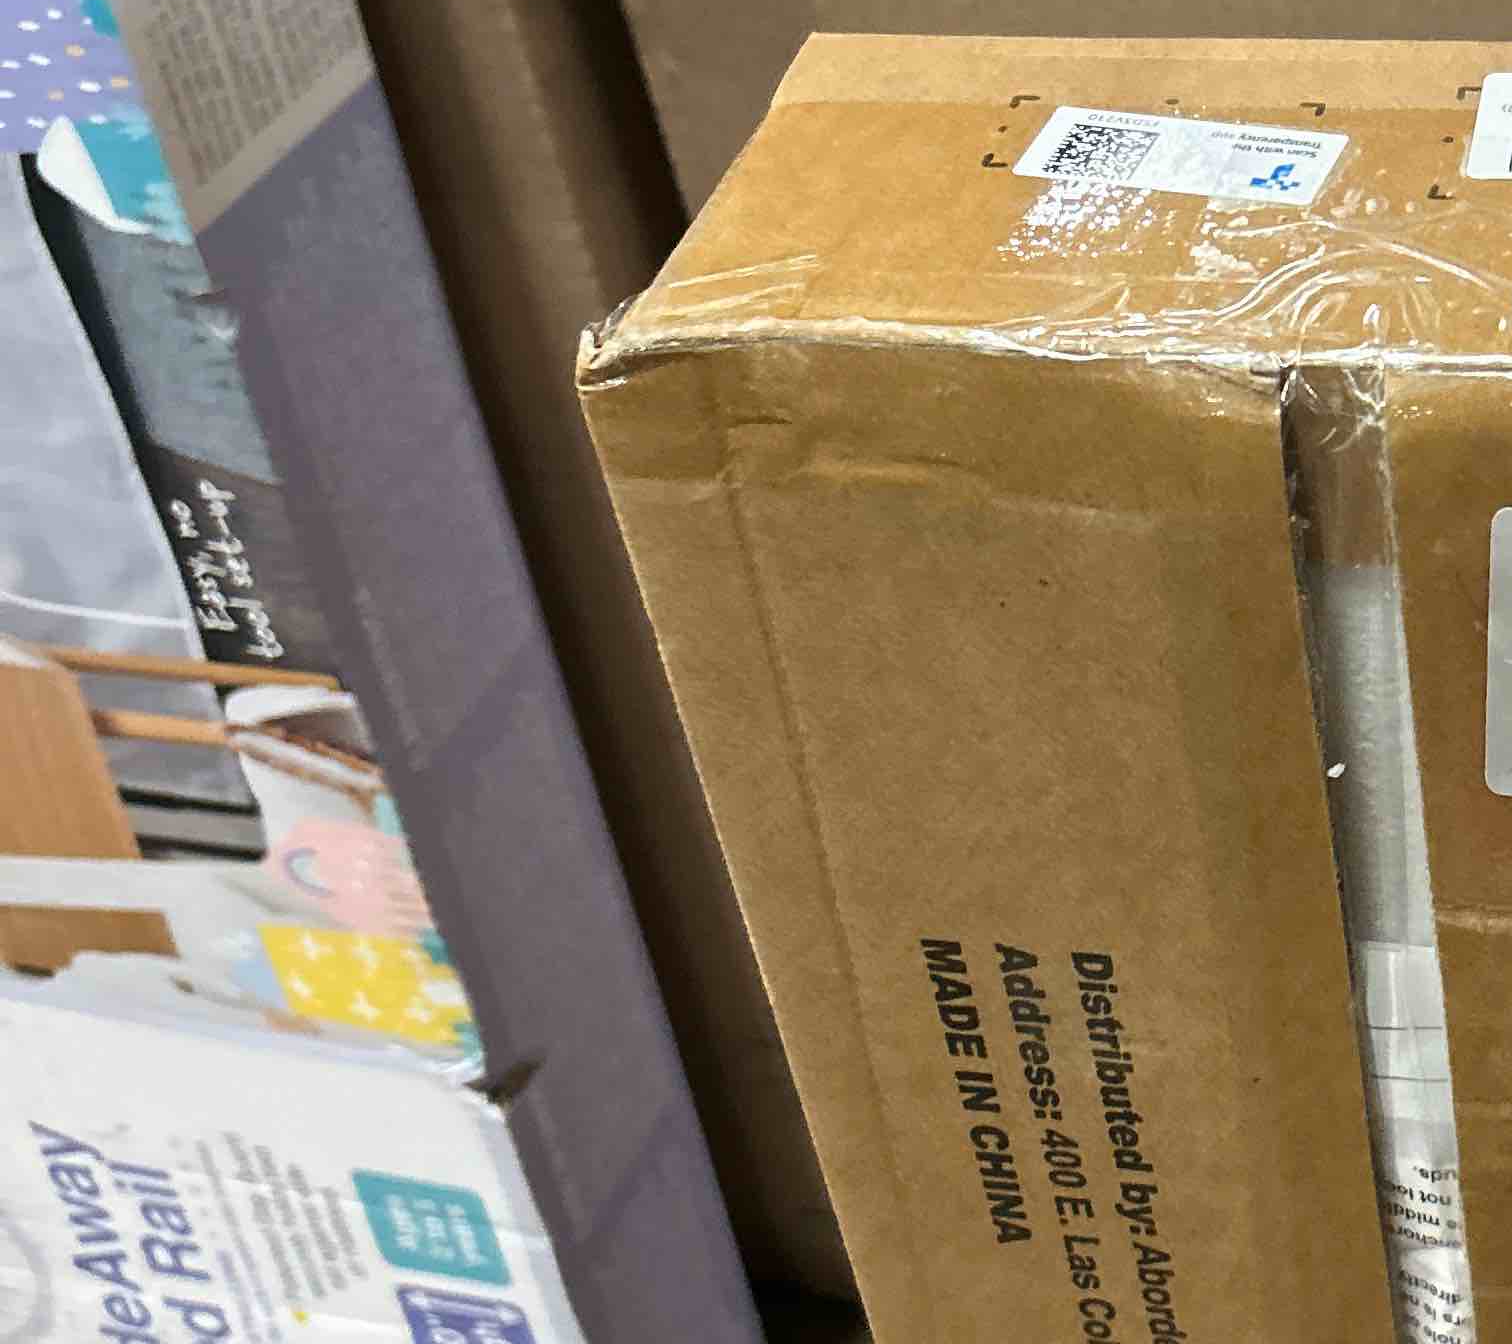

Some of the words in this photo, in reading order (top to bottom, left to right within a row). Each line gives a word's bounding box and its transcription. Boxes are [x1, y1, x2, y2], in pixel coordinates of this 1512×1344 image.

[1256, 144, 1287, 156] with
[1291, 147, 1319, 159] Scan
[920, 939, 988, 1059] MADE
[995, 942, 1063, 1121] Address:
[954, 1070, 1001, 1113] IN
[1071, 951, 1155, 1173] Distributed
[1114, 1181, 1158, 1236] by:
[969, 1125, 1032, 1244] CHINA
[1041, 1128, 1087, 1189] 400
[106, 1160, 211, 1282] Rail
[1054, 1195, 1095, 1225] E.
[1379, 1202, 1441, 1227] middl
[1419, 1189, 1452, 1206] not
[1063, 1234, 1101, 1290] Las
